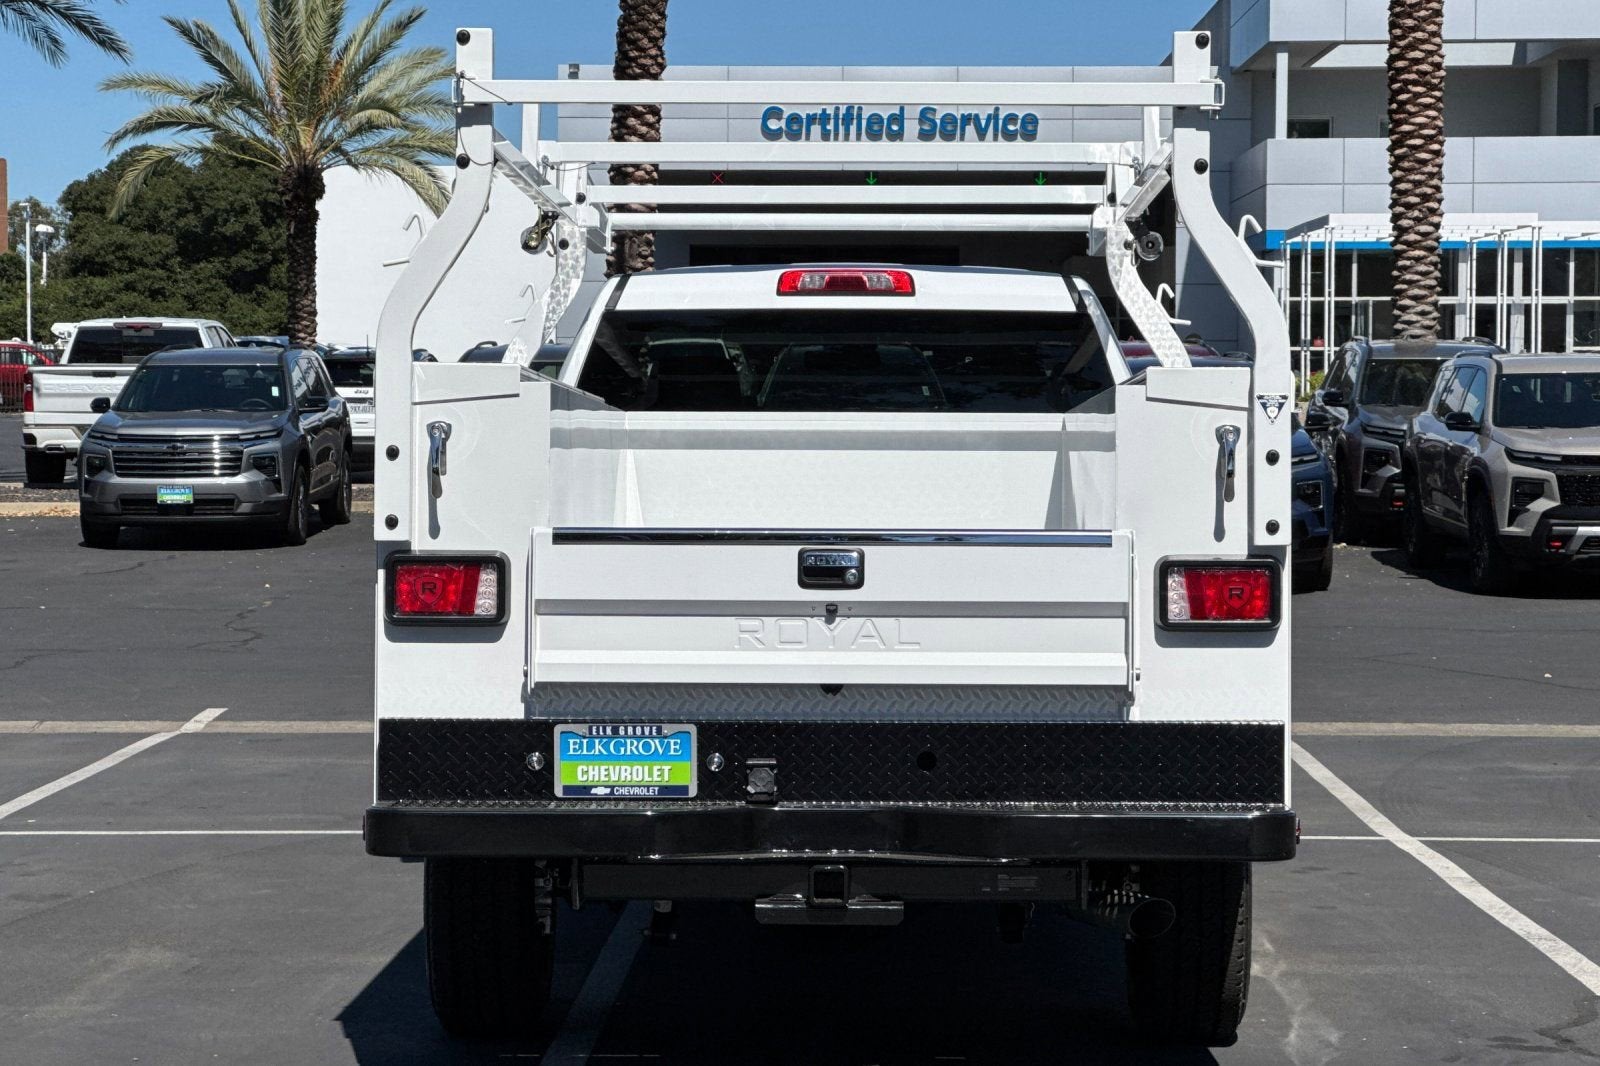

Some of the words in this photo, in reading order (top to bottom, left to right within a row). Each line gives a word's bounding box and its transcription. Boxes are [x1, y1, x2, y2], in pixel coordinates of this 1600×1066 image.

[760, 105, 905, 138] Certified
[917, 105, 1040, 138] Service
[806, 555, 856, 565] ROYAL
[733, 617, 921, 649] ROYAL
[592, 726, 613, 736] ELK
[619, 726, 657, 736] GROVE
[576, 765, 672, 783] CHEVROLET
[613, 786, 660, 796] CHEVROLET
